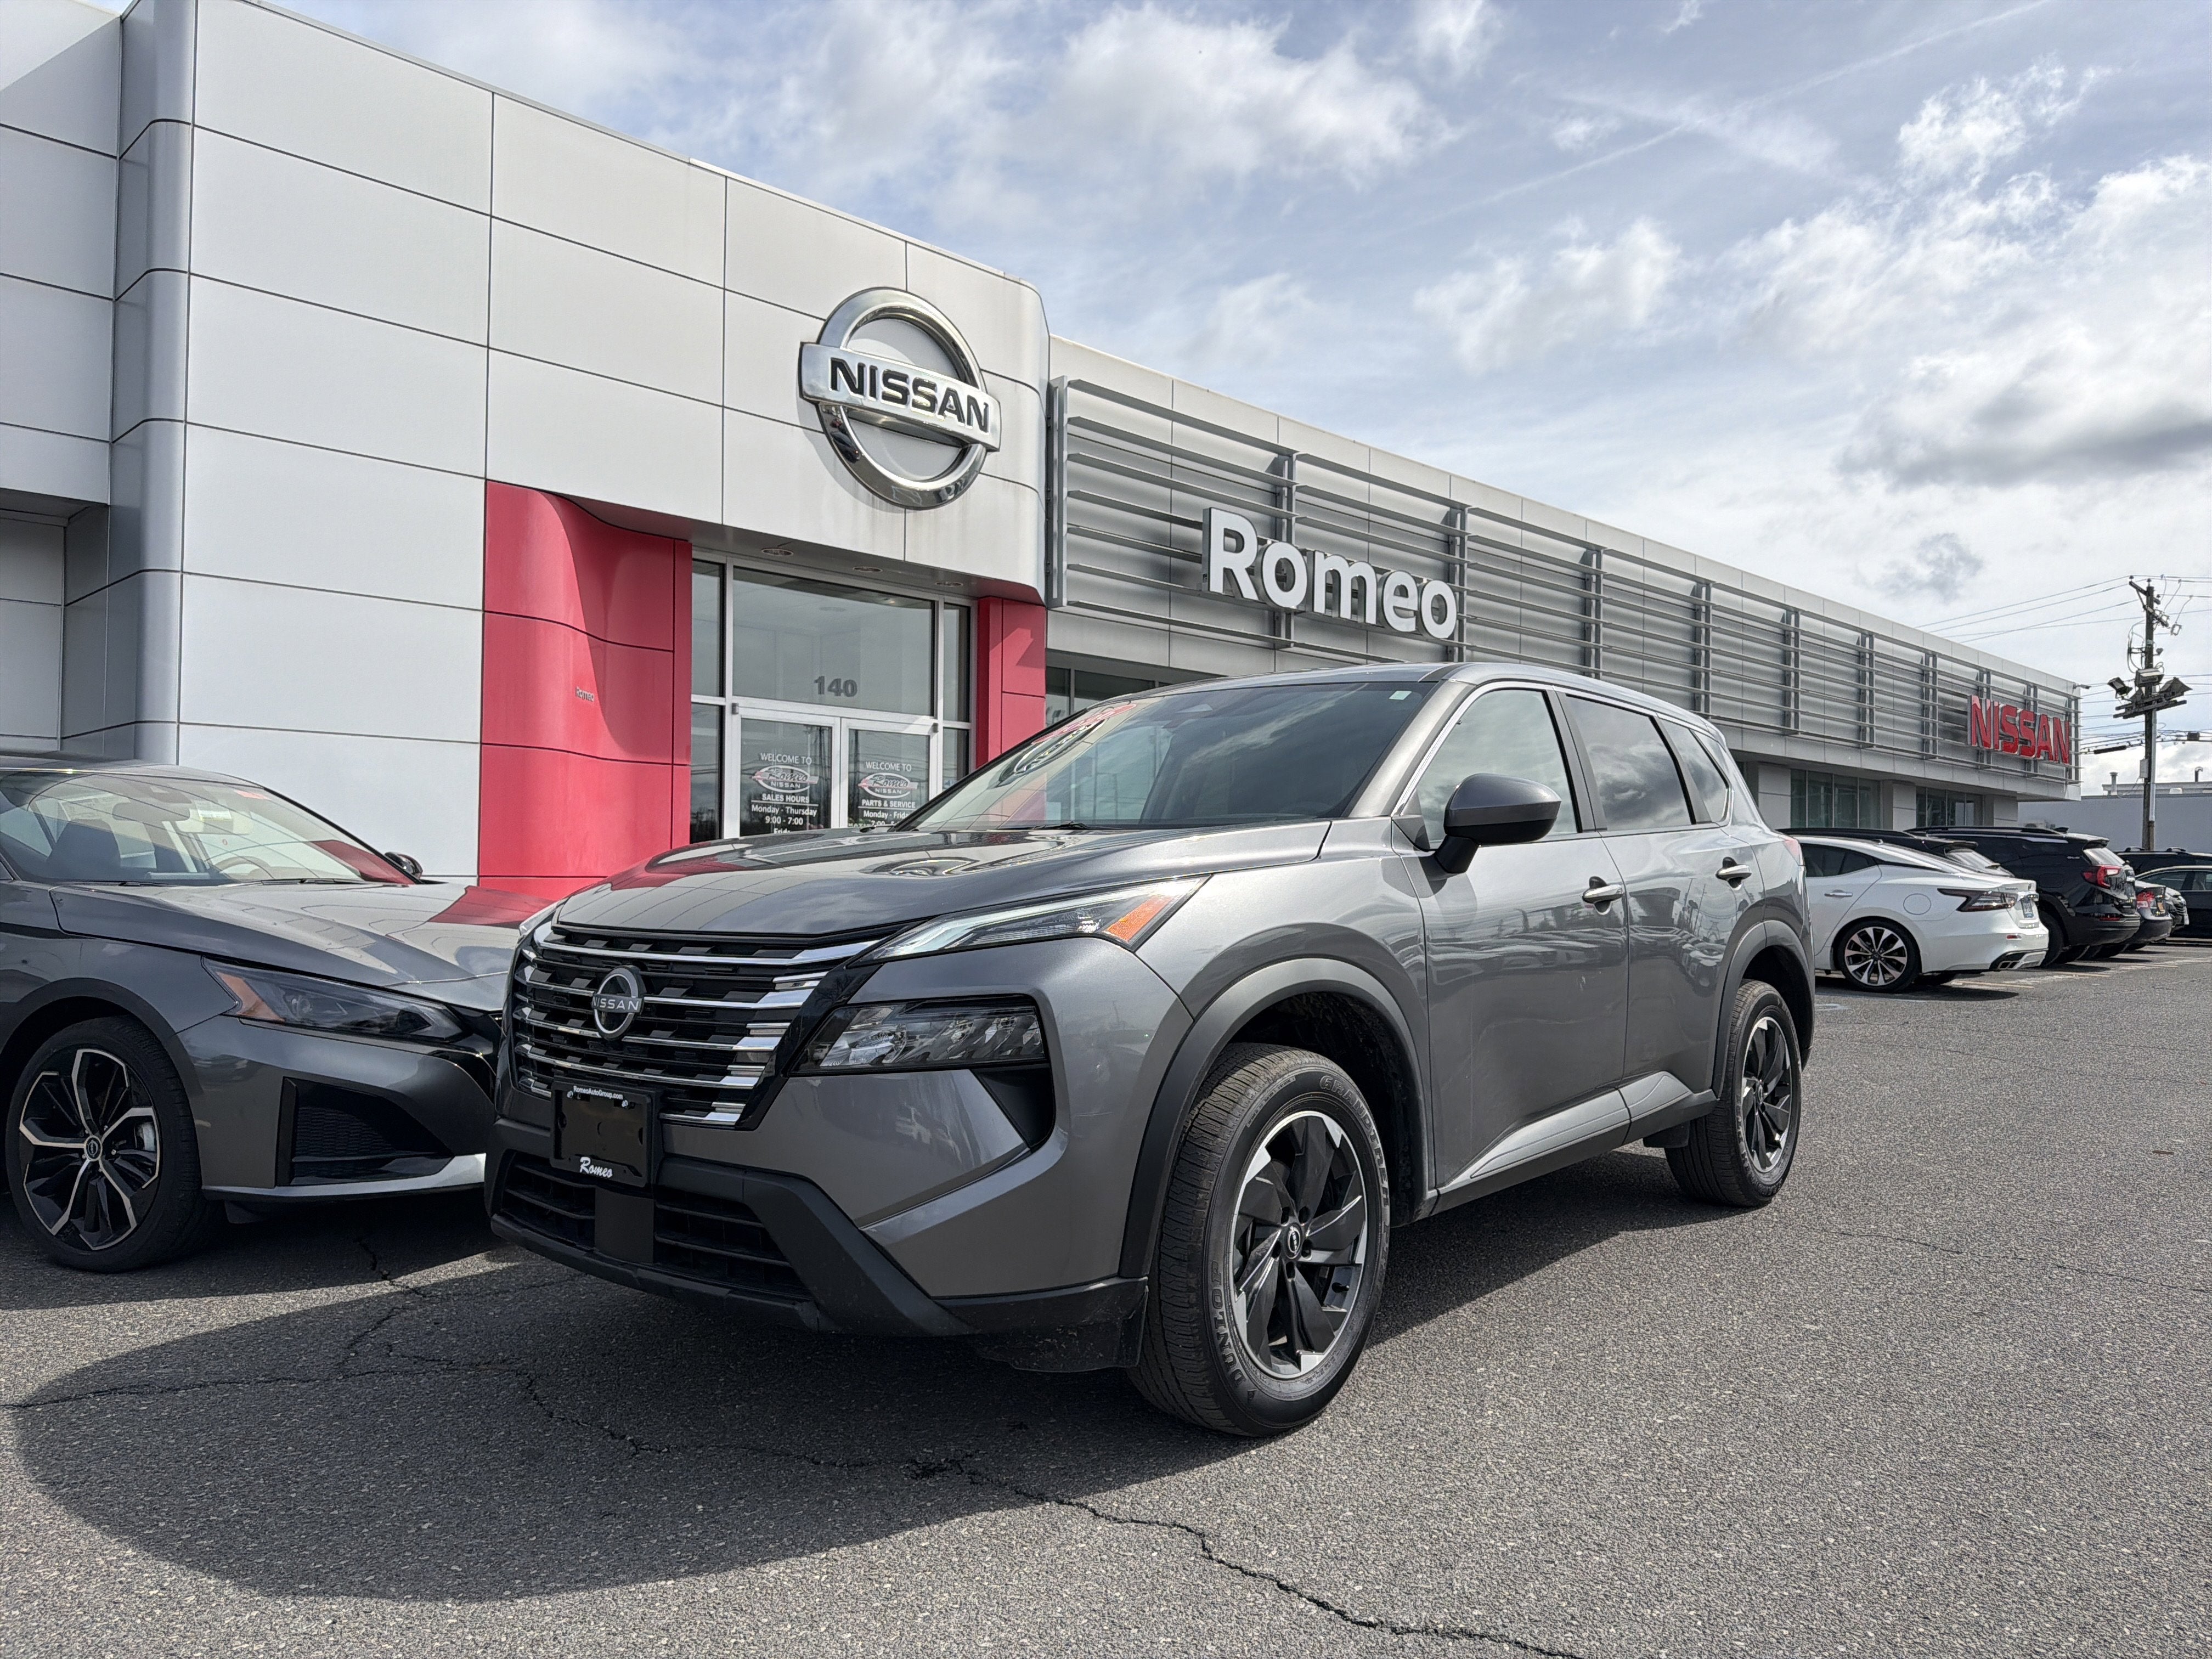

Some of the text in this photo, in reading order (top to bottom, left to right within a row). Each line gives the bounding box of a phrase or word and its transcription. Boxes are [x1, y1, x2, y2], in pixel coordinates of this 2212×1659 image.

[829, 357, 989, 435] NISSAN
[1203, 507, 1457, 639] Romeo
[575, 686, 595, 702] Romeo
[814, 676, 857, 697] 140
[1968, 695, 2070, 765] NISSAN
[760, 752, 812, 765] WELCOME TO
[866, 761, 912, 772] WELCOME TO
[765, 767, 808, 782] Romeo
[870, 774, 909, 787] Romeo
[761, 793, 810, 804] SALES HOURS
[862, 799, 882, 807] PARTS
[751, 804, 779, 815] Monday
[785, 806, 817, 817] Thursday
[863, 810, 889, 820] Monday
[765, 816, 781, 825] 9:00
[787, 817, 804, 826] 7:00
[592, 996, 639, 1011] NISSAN
[573, 1085, 624, 1100] RomeoAutoGroup.com
[579, 1156, 613, 1178] Romeo
[1211, 1260, 1247, 1386] DUNLOP
